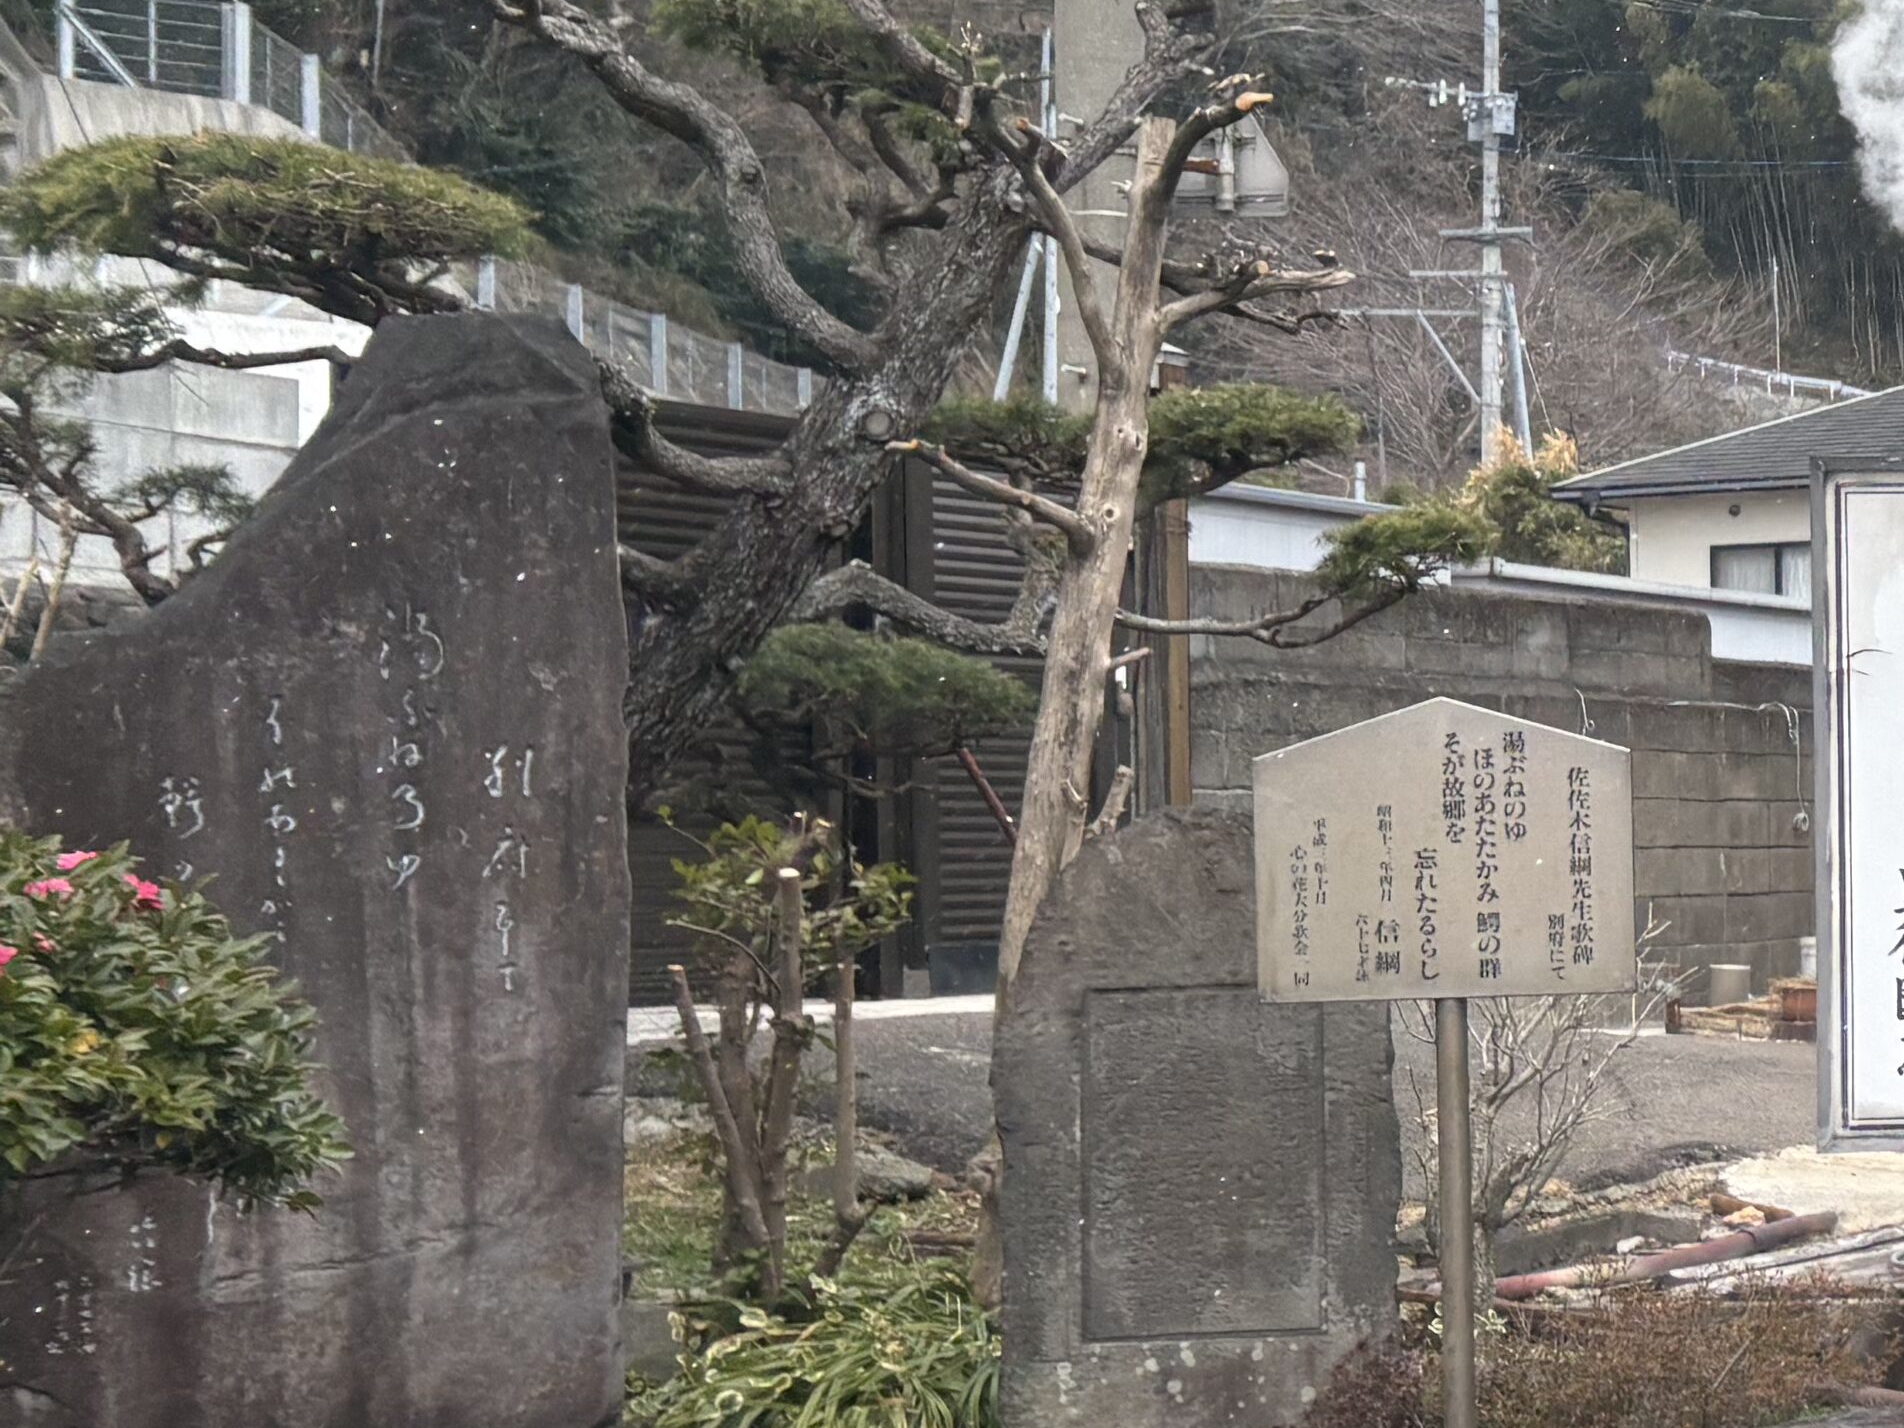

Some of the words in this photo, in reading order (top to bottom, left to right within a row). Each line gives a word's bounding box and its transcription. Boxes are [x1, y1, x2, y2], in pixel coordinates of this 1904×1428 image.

[1442, 732, 1466, 844] そが故郷を
[1503, 731, 1527, 842] 湯ぶねのゆ
[1413, 847, 1440, 981] 忘れたるらし
[1567, 767, 1595, 966] 佐佐木信綱先生歌碑
[1547, 913, 1566, 981] 別府にて
